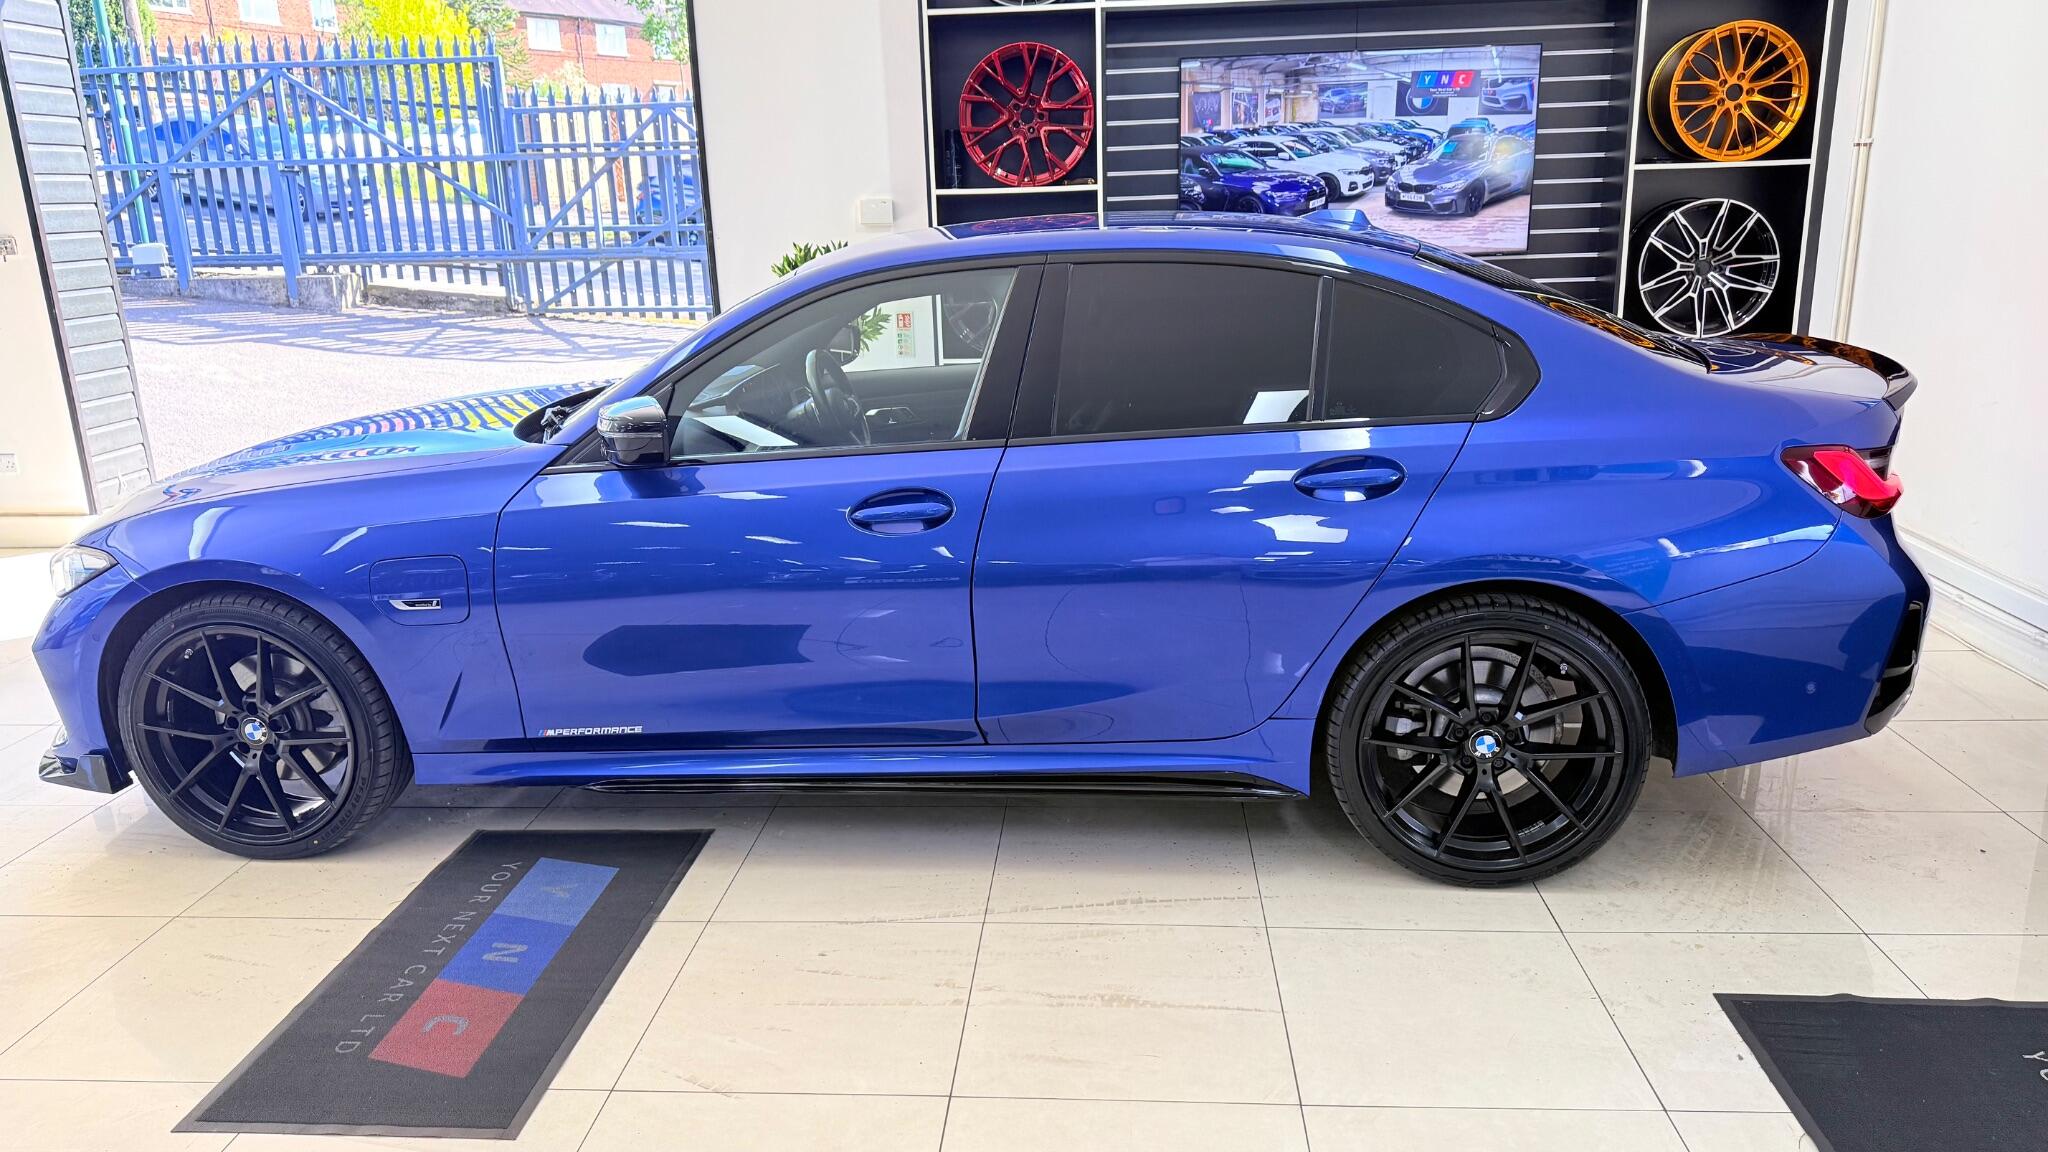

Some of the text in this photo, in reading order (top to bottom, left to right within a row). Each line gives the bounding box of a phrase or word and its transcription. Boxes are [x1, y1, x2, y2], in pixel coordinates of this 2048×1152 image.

[335, 861, 521, 1054] YOUR NEXT CAR LTD
